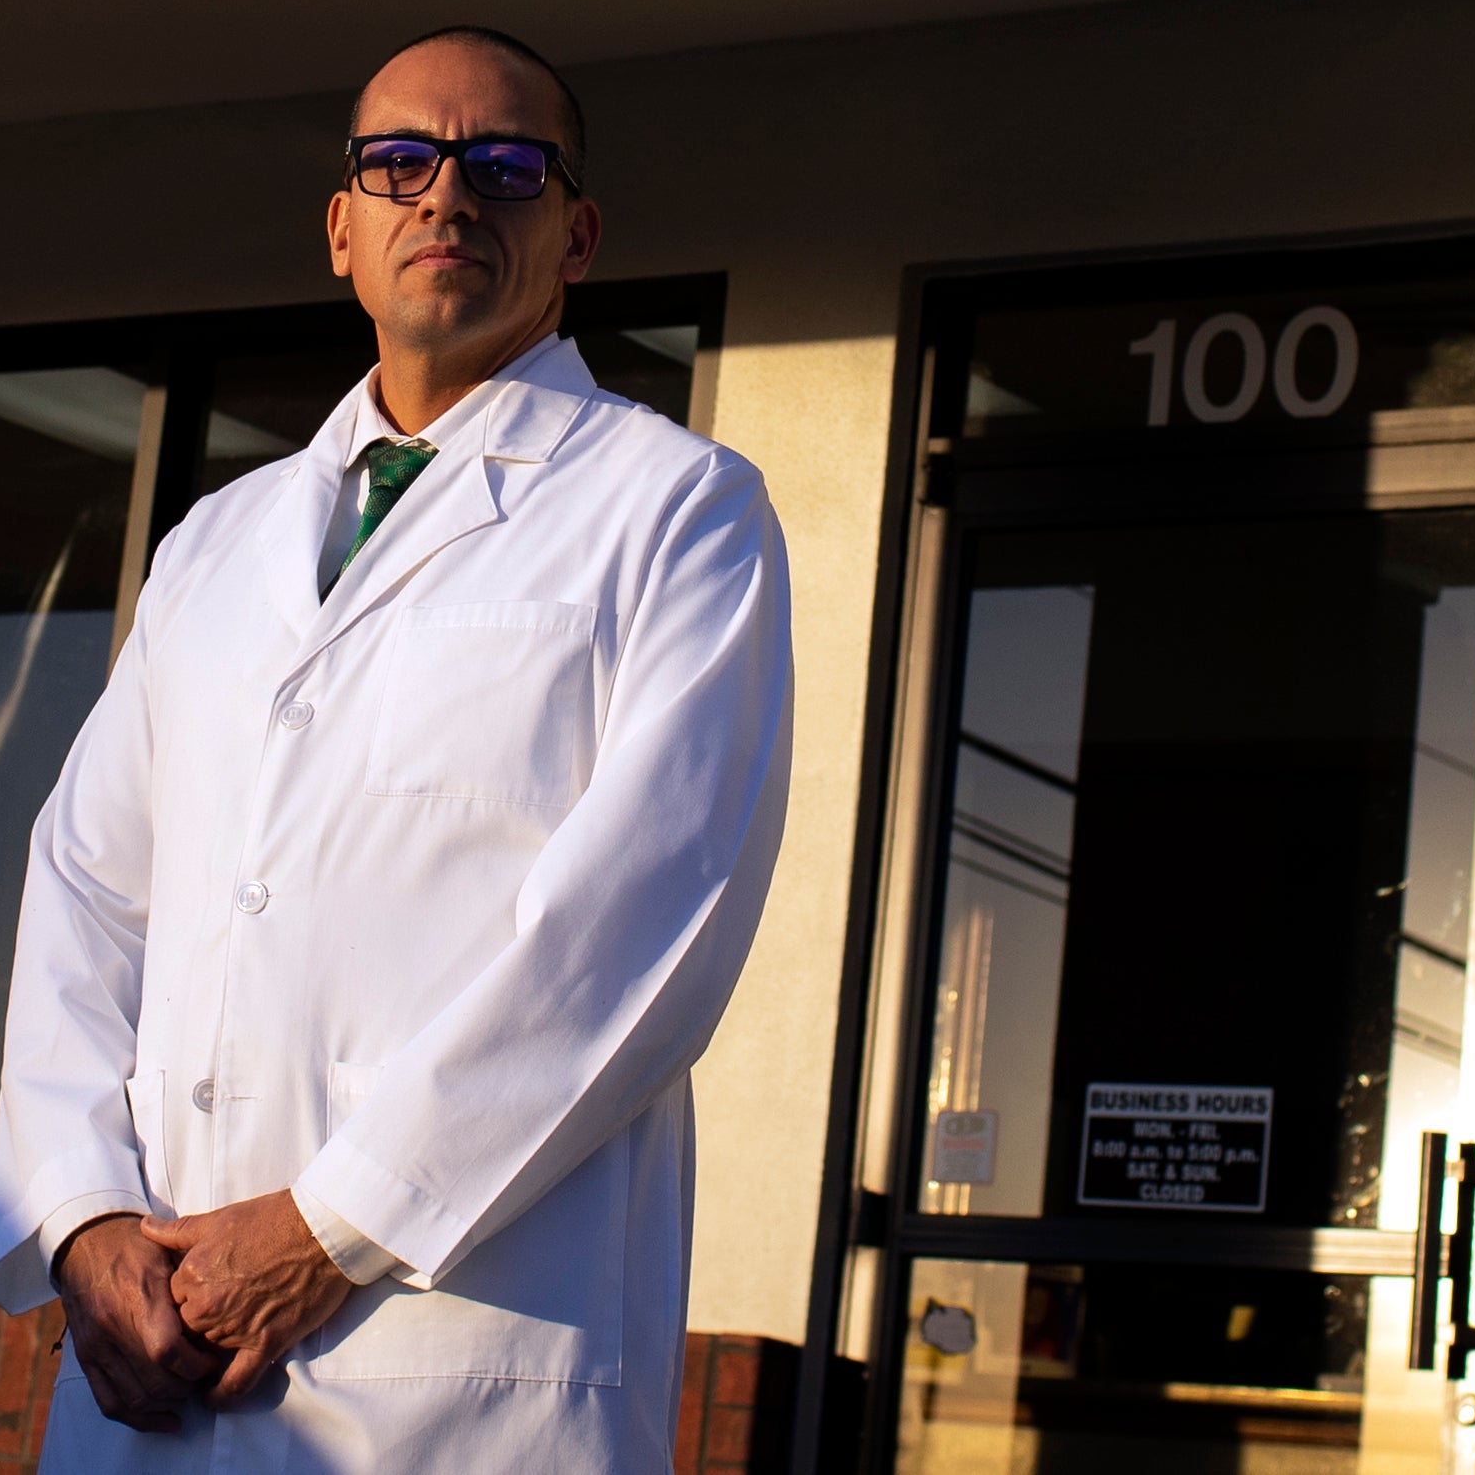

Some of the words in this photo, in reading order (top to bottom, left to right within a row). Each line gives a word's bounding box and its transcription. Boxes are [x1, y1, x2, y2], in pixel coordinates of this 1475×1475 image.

[1127, 304, 1360, 428] 100
[1090, 1090, 1190, 1113] BUSINESS
[1196, 1093, 1267, 1115] HOURS
[1133, 1121, 1175, 1139] MON.
[1167, 1144, 1185, 1161] to
[1224, 1148, 1260, 1166] p.m.
[1127, 1162, 1160, 1180] SAT.
[1139, 1183, 1205, 1203] CLOSED
